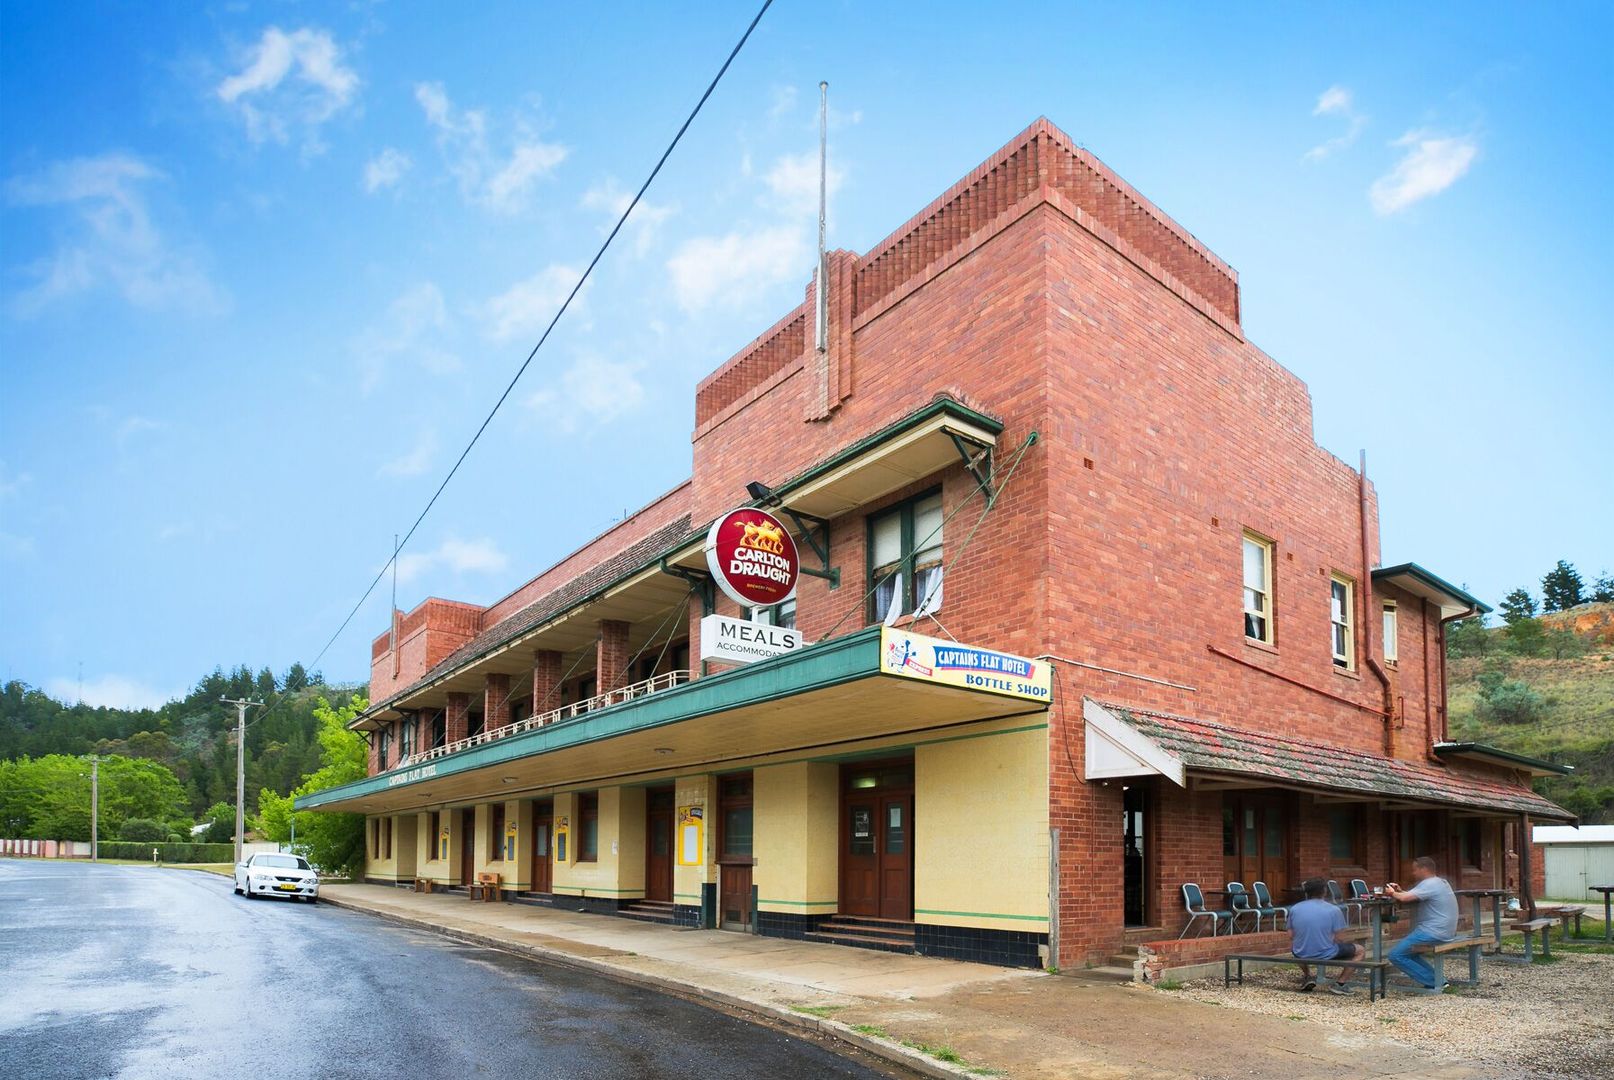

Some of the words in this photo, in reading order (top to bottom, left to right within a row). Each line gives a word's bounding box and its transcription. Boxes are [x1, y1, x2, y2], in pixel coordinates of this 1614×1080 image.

[734, 547, 790, 572] CARLTON
[730, 560, 791, 586] DRAUGHT
[721, 622, 795, 649] MEALS
[938, 651, 978, 667] CAPTAINS
[981, 654, 1001, 670] FLAT
[1002, 659, 1026, 675] HOTEL
[966, 674, 1012, 691] BOTTLE
[1017, 684, 1048, 697] SHOP
[409, 769, 420, 781] FLAT
